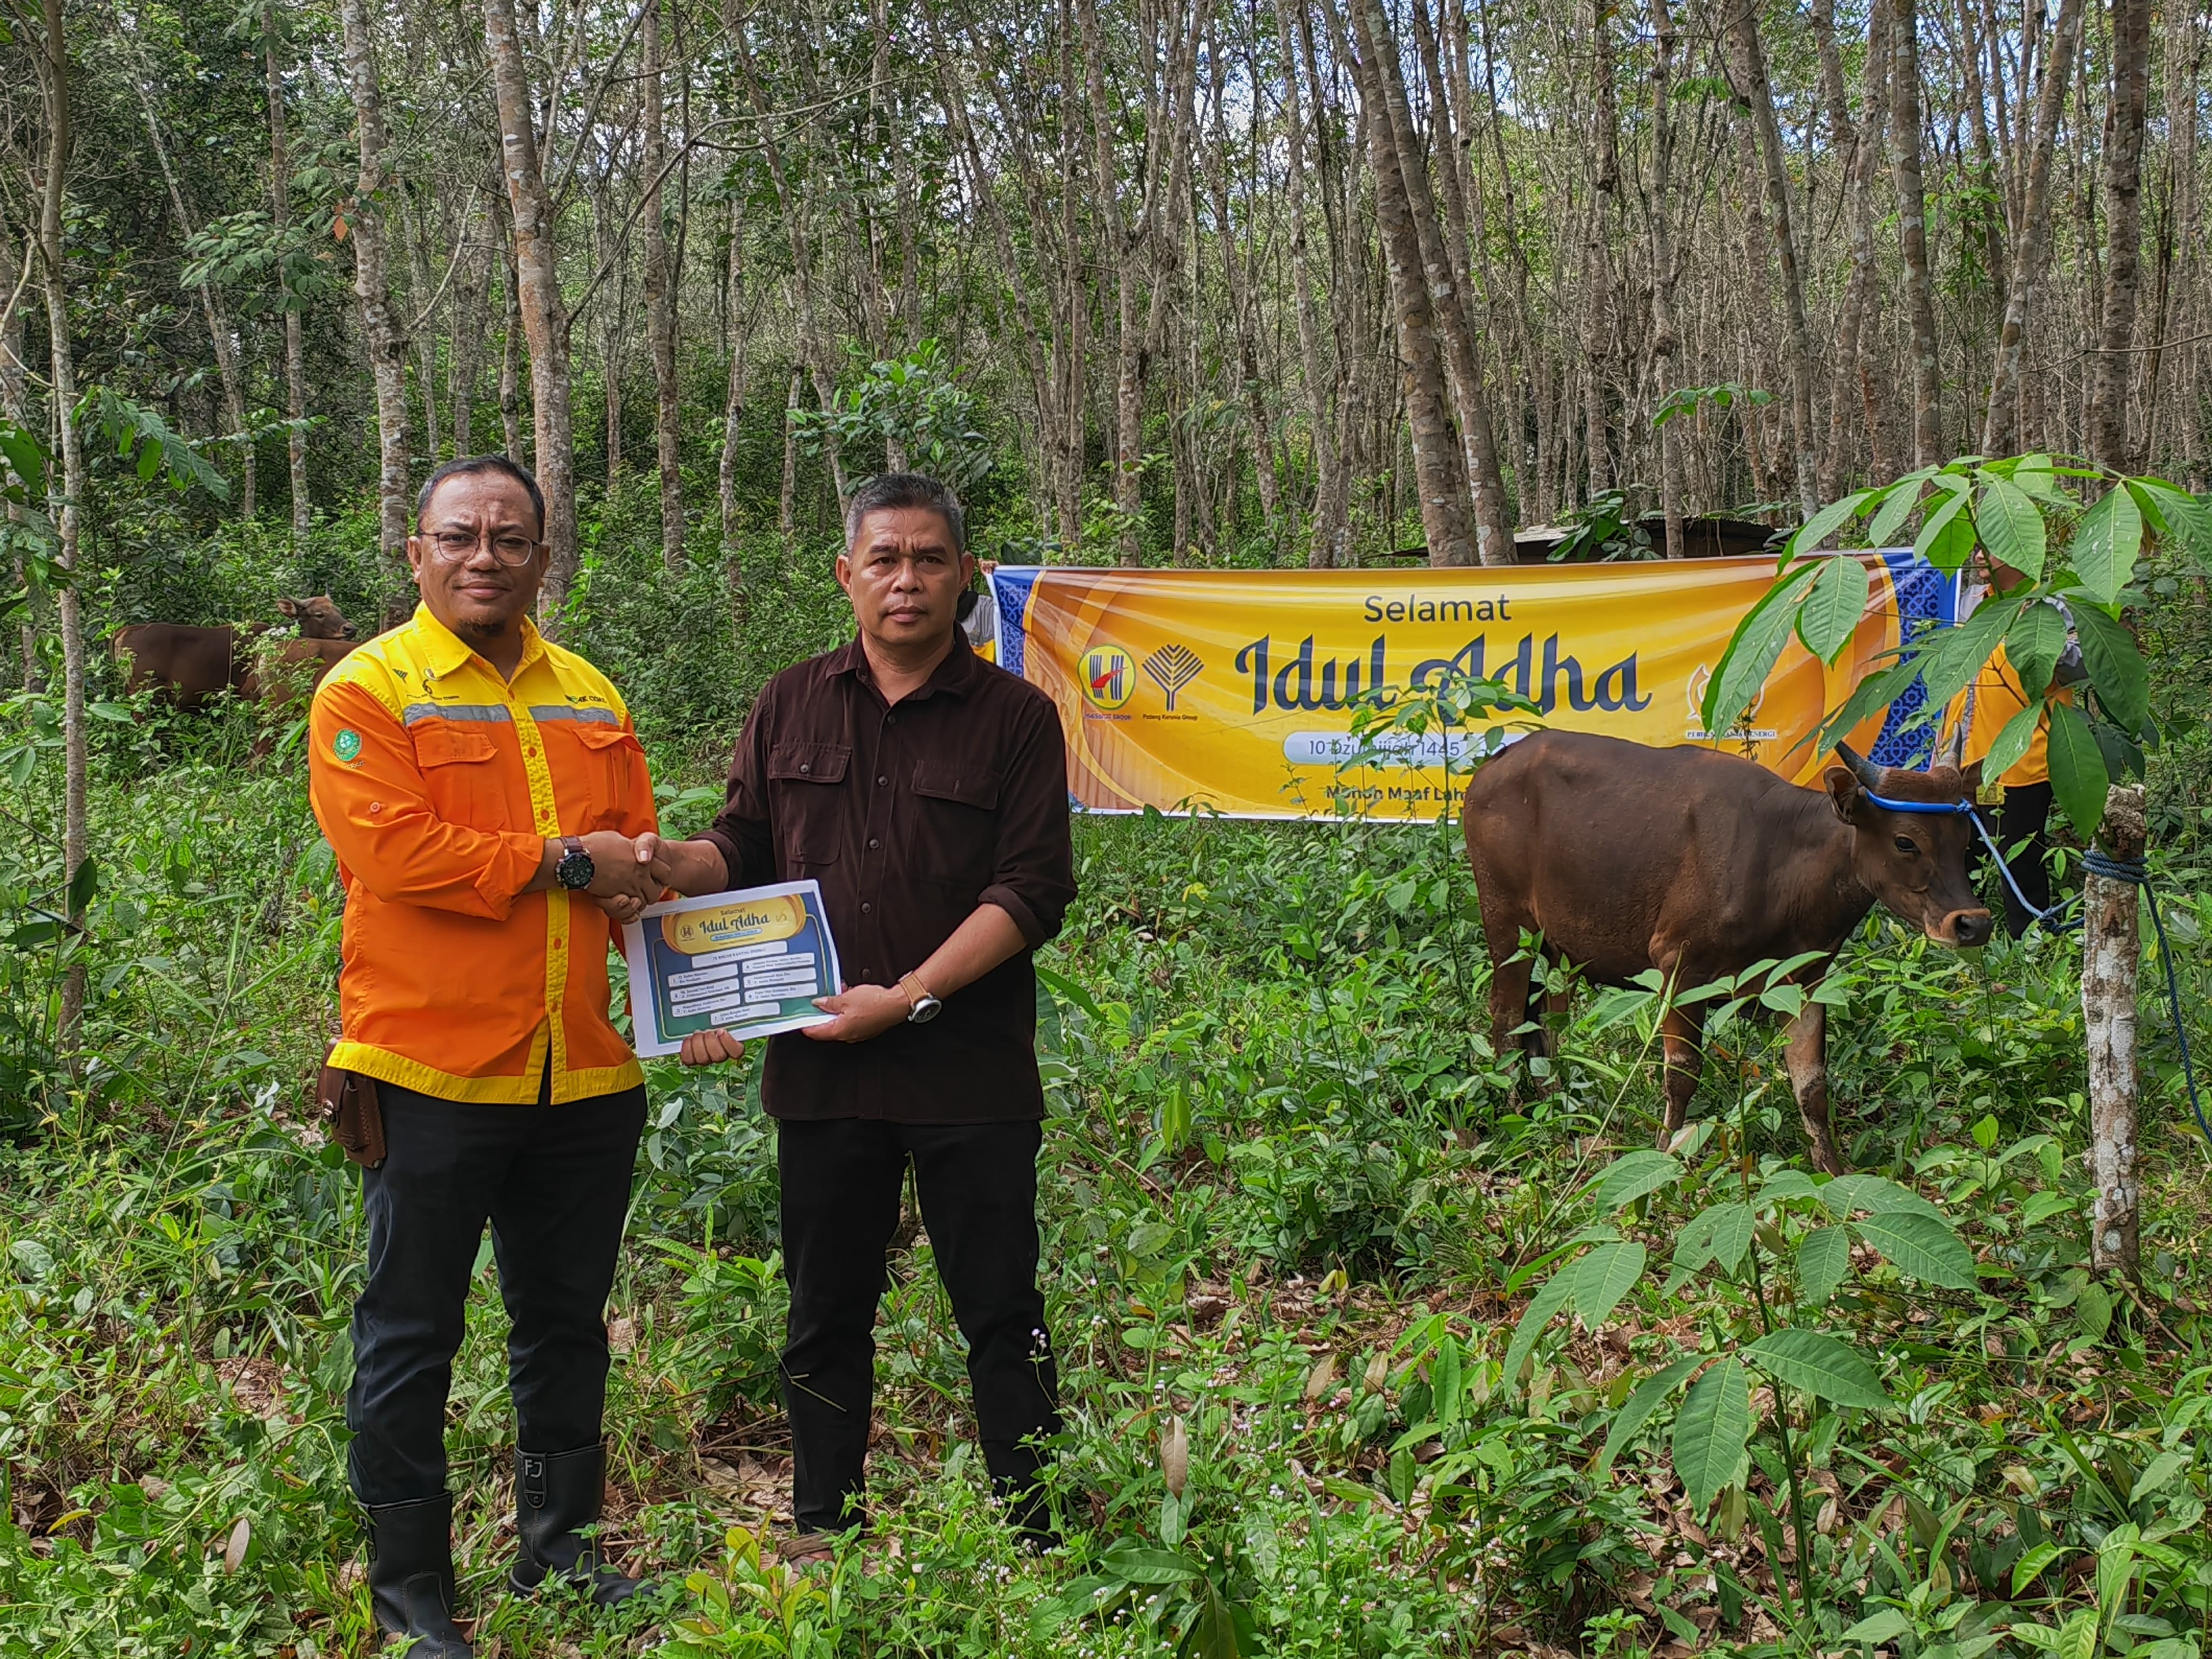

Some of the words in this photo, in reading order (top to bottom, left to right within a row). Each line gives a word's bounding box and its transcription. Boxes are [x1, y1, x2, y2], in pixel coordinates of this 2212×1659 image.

[1364, 594, 1512, 622] Selamat
[1235, 633, 1397, 716] Idul
[1410, 630, 1653, 726] Adha
[1310, 740, 1326, 755] 10
[1421, 741, 1460, 756] 1445
[699, 918, 729, 934] Idul
[731, 913, 770, 930] Adha
